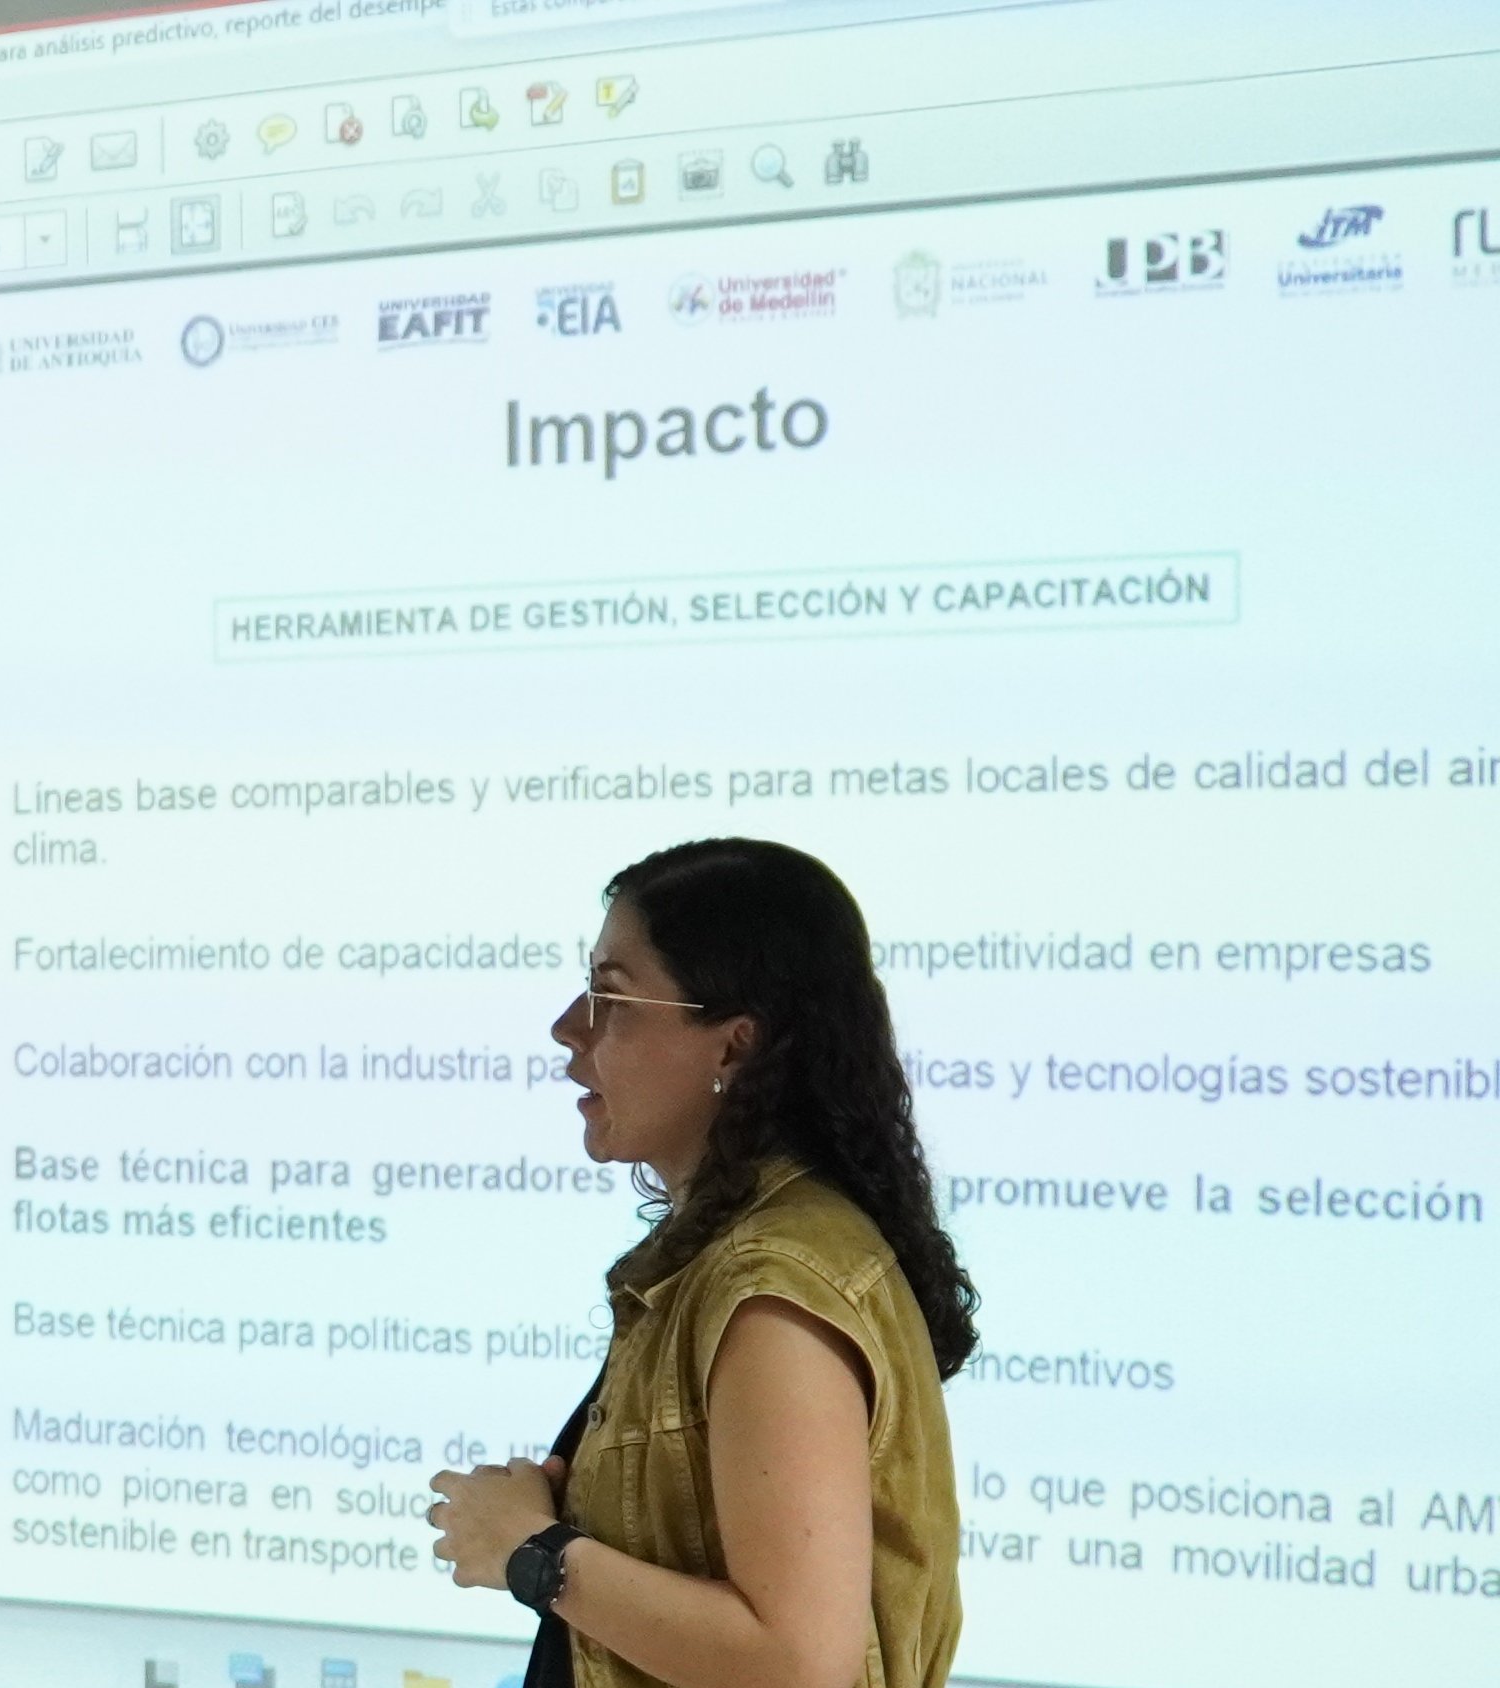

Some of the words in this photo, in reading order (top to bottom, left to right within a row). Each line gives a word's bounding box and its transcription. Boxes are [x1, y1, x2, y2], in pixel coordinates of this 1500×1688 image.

[34, 31, 106, 59] análisis
[112, 19, 218, 53] predictivo,
[225, 8, 301, 42] reporte
[309, 2, 341, 25] del
[718, 268, 836, 296] Universidad
[950, 269, 1049, 293] NACIONAL
[1277, 264, 1404, 288] Universitaria
[379, 291, 491, 312] UNIVERSIDAD
[556, 295, 622, 337] EIA
[718, 297, 744, 316] de
[9, 328, 135, 352] UNIVERSIDAD
[377, 306, 491, 343] EAFIT
[9, 355, 31, 372] DE
[504, 383, 830, 480] Impacto
[231, 598, 458, 643] HERRAMIENTA
[469, 602, 512, 633] DE
[522, 590, 680, 633] GESTIÓN,
[689, 580, 888, 623] SELECCIÓN
[899, 584, 923, 614] Y
[933, 567, 1213, 613] CAPACITACIÓN
[12, 779, 125, 816] Líneas
[136, 775, 218, 812] base
[230, 769, 456, 819] comparables
[470, 777, 490, 813] y
[503, 763, 714, 804] verificables
[727, 764, 813, 807] para
[830, 761, 951, 797] metas
[966, 755, 1111, 795] locales
[1126, 752, 1178, 792] de
[1194, 749, 1348, 791] calidad
[1363, 747, 1432, 789] del
[12, 834, 109, 867] clima.
[12, 935, 271, 974] Fortalecimiento
[282, 935, 325, 971] de
[337, 932, 564, 976] capacidades
[1150, 942, 1198, 972] en
[1217, 938, 1431, 982] empresas
[12, 1040, 232, 1081] Colaboración
[245, 1052, 306, 1080] con
[319, 1043, 349, 1081] la
[361, 1043, 513, 1084] industria
[1009, 1060, 1033, 1100] y
[1047, 1053, 1290, 1102] tecnologías
[1305, 1058, 1500, 1100] sostenibl
[12, 1147, 100, 1182] Base
[119, 1149, 249, 1186] técnica
[269, 1157, 351, 1192] para
[371, 1155, 616, 1198] generadores
[949, 1172, 1169, 1215] promueve
[1195, 1173, 1233, 1214] la
[1257, 1177, 1485, 1223] selección
[12, 1201, 110, 1236] flotas
[123, 1202, 196, 1238] más
[208, 1203, 388, 1244] eficientes
[12, 1302, 96, 1339] Base
[107, 1306, 226, 1346] técnica
[238, 1318, 316, 1355] para
[326, 1315, 474, 1360] políticas
[12, 1407, 206, 1451] Maduración
[225, 1420, 423, 1470] tecnológica
[443, 1431, 488, 1467] de
[12, 1467, 103, 1500] como
[122, 1470, 249, 1512] pionera
[270, 1483, 314, 1513] en
[972, 1459, 1006, 1501] lo
[1029, 1472, 1107, 1515] que
[1131, 1476, 1333, 1524] posiciona
[1358, 1489, 1396, 1529] al
[1419, 1491, 1500, 1536] AM
[12, 1517, 179, 1557] sostenible
[189, 1530, 232, 1560] en
[244, 1528, 420, 1576] transporte
[1068, 1537, 1144, 1571] una
[1172, 1542, 1377, 1591] movilidad
